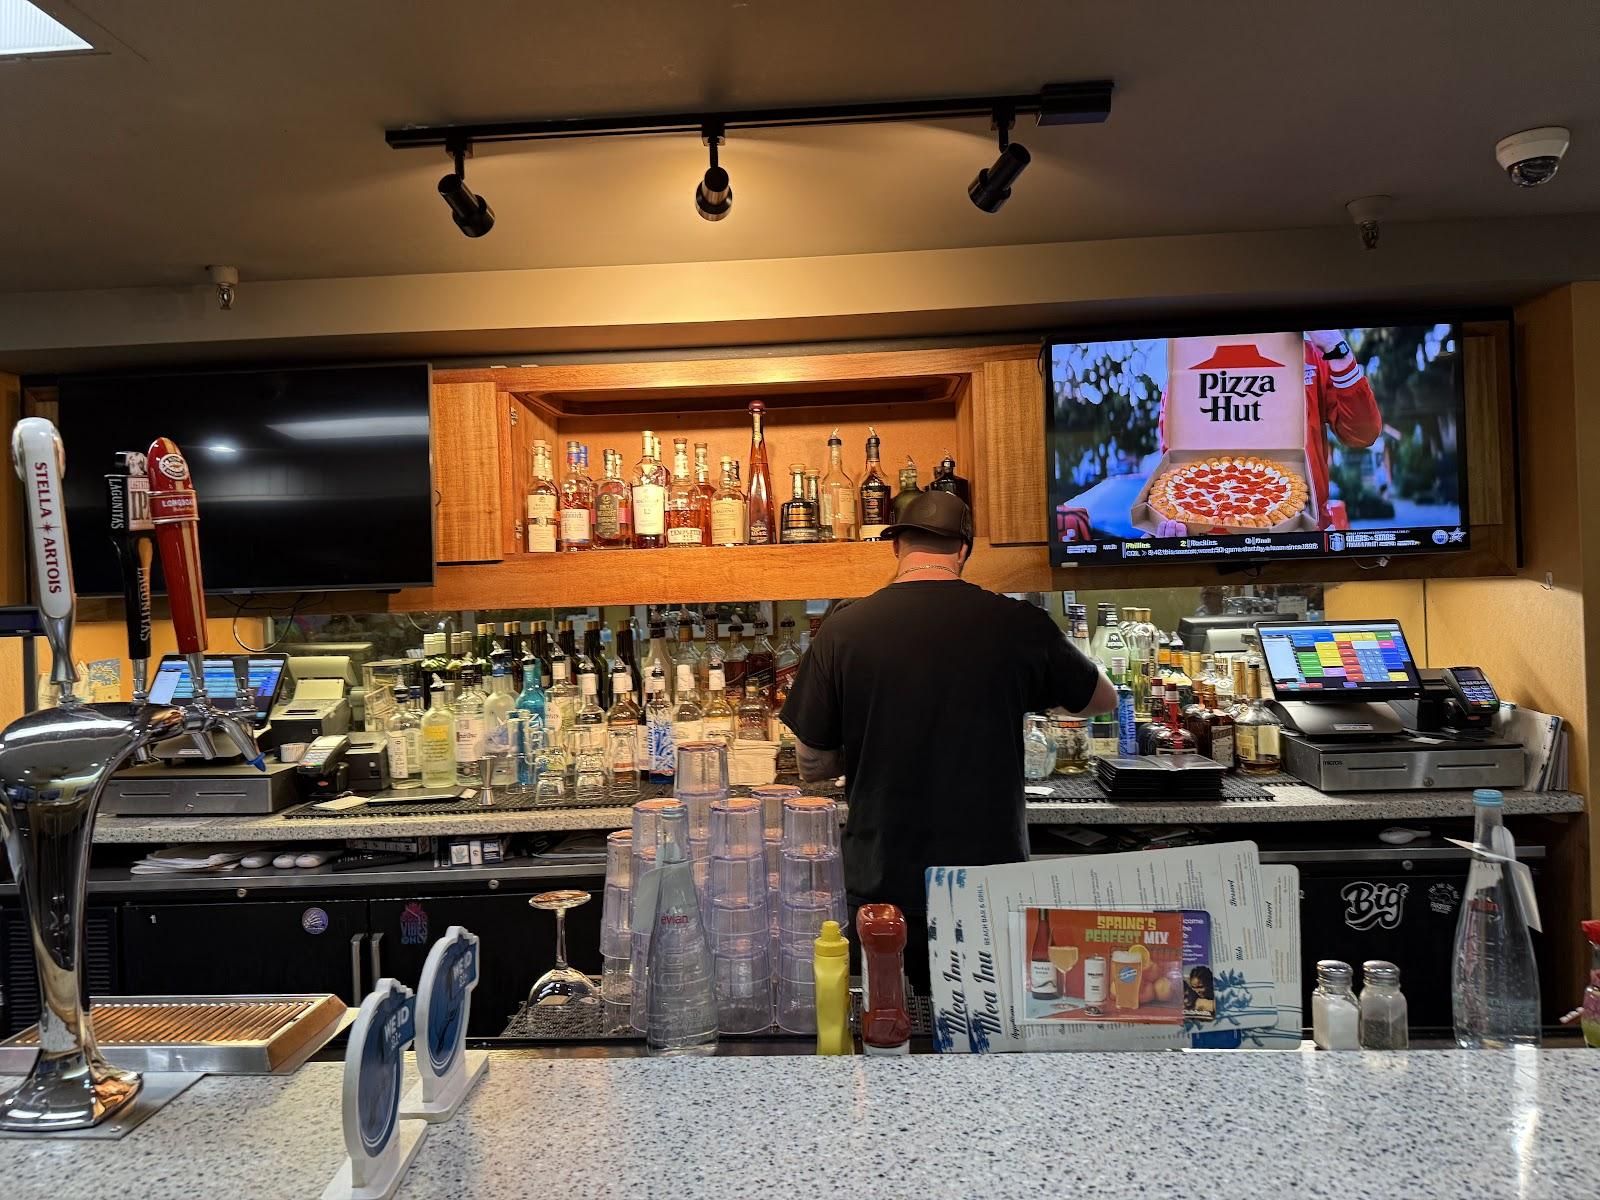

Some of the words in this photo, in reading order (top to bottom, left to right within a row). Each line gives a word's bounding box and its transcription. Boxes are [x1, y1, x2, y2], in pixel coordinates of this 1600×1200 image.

[1199, 370, 1276, 399] Pizza
[1200, 396, 1262, 421] Hut
[34, 462, 53, 518] STELLA
[108, 478, 124, 530] LAGUNITAS
[43, 537, 62, 594] ARTOIS
[136, 567, 152, 642] LAGUNITAS
[976, 884, 985, 903] GRILL
[1341, 881, 1409, 931] Big
[661, 915, 689, 925] evian
[1097, 915, 1157, 930] SPRING'S
[401, 936, 428, 945] ONLY
[1085, 929, 1142, 943] PERFECT
[1144, 931, 1169, 945] MIX
[974, 990, 1002, 1035] Mea
